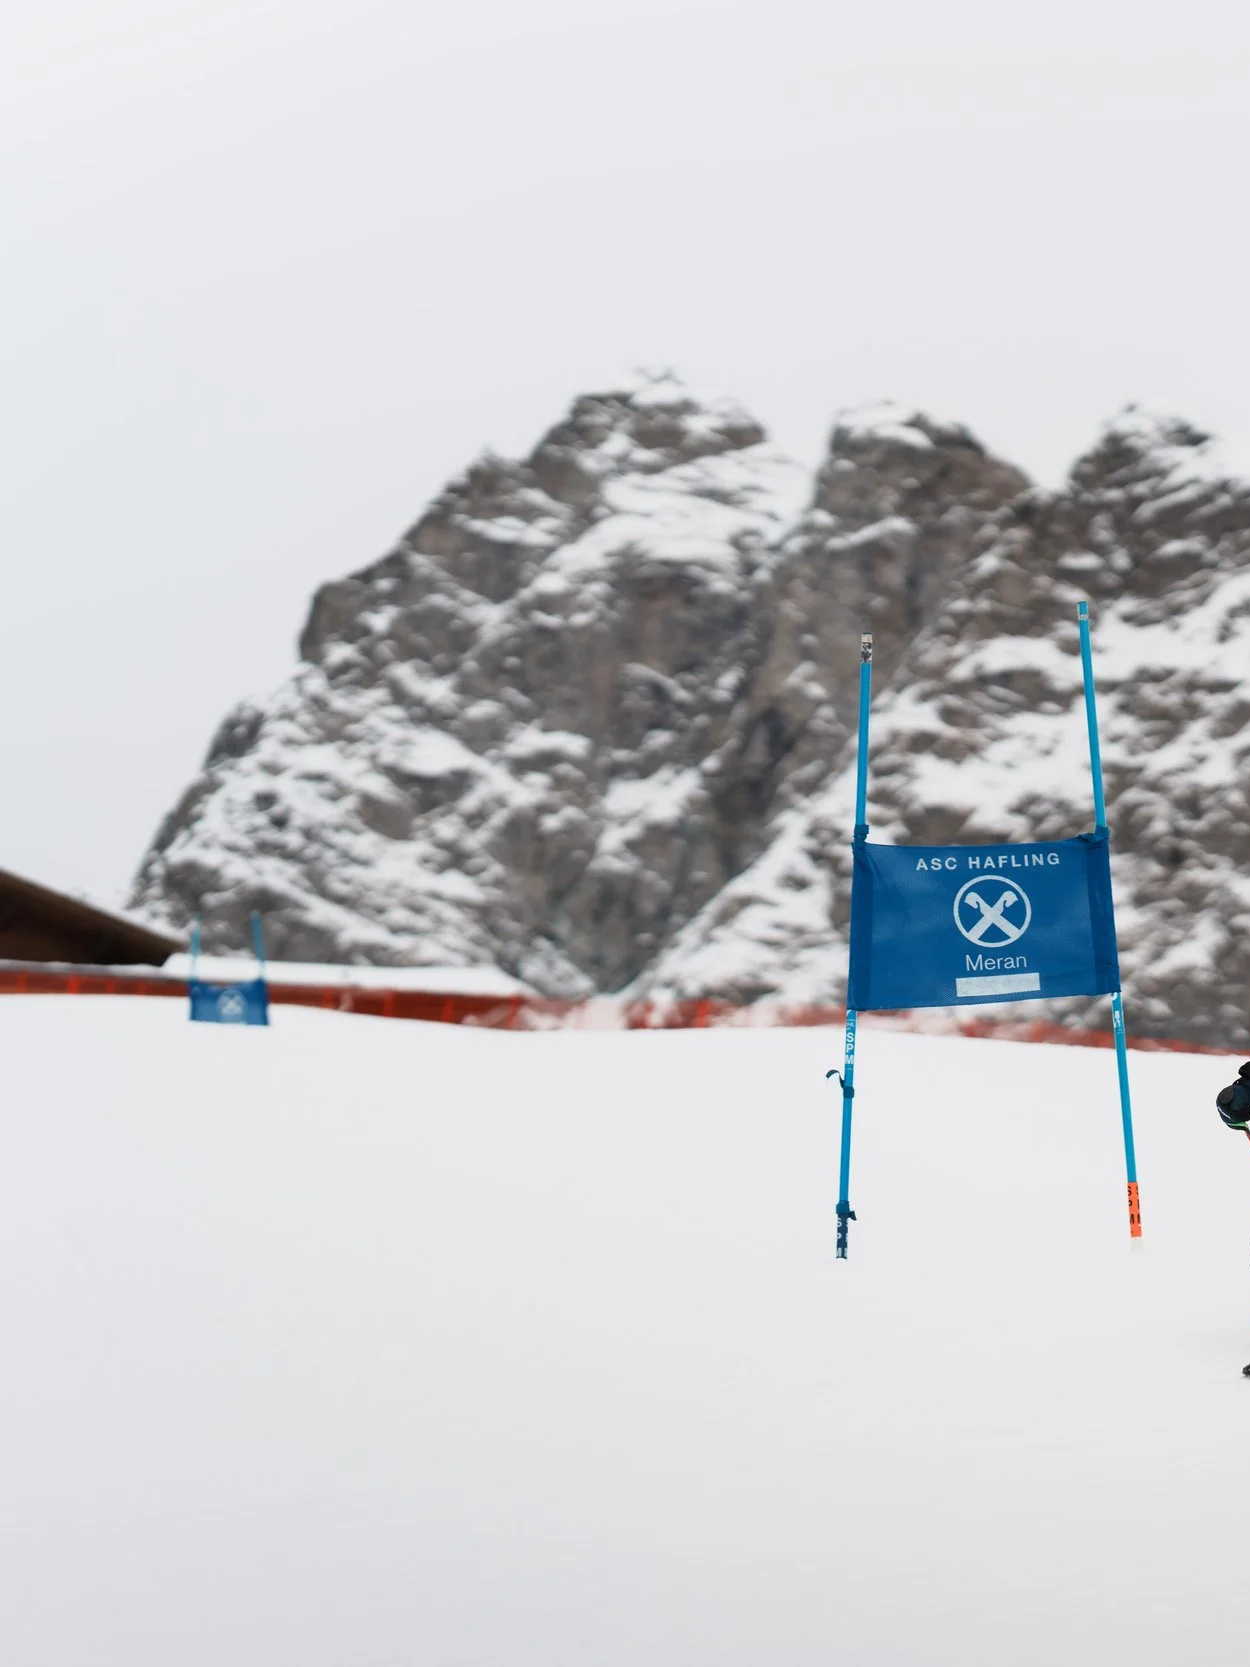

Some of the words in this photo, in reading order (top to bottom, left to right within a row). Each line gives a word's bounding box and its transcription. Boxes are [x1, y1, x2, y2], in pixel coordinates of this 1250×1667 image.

[915, 857, 958, 871] ASC
[968, 852, 1061, 870] HAFLING
[965, 953, 1027, 972] Meran
